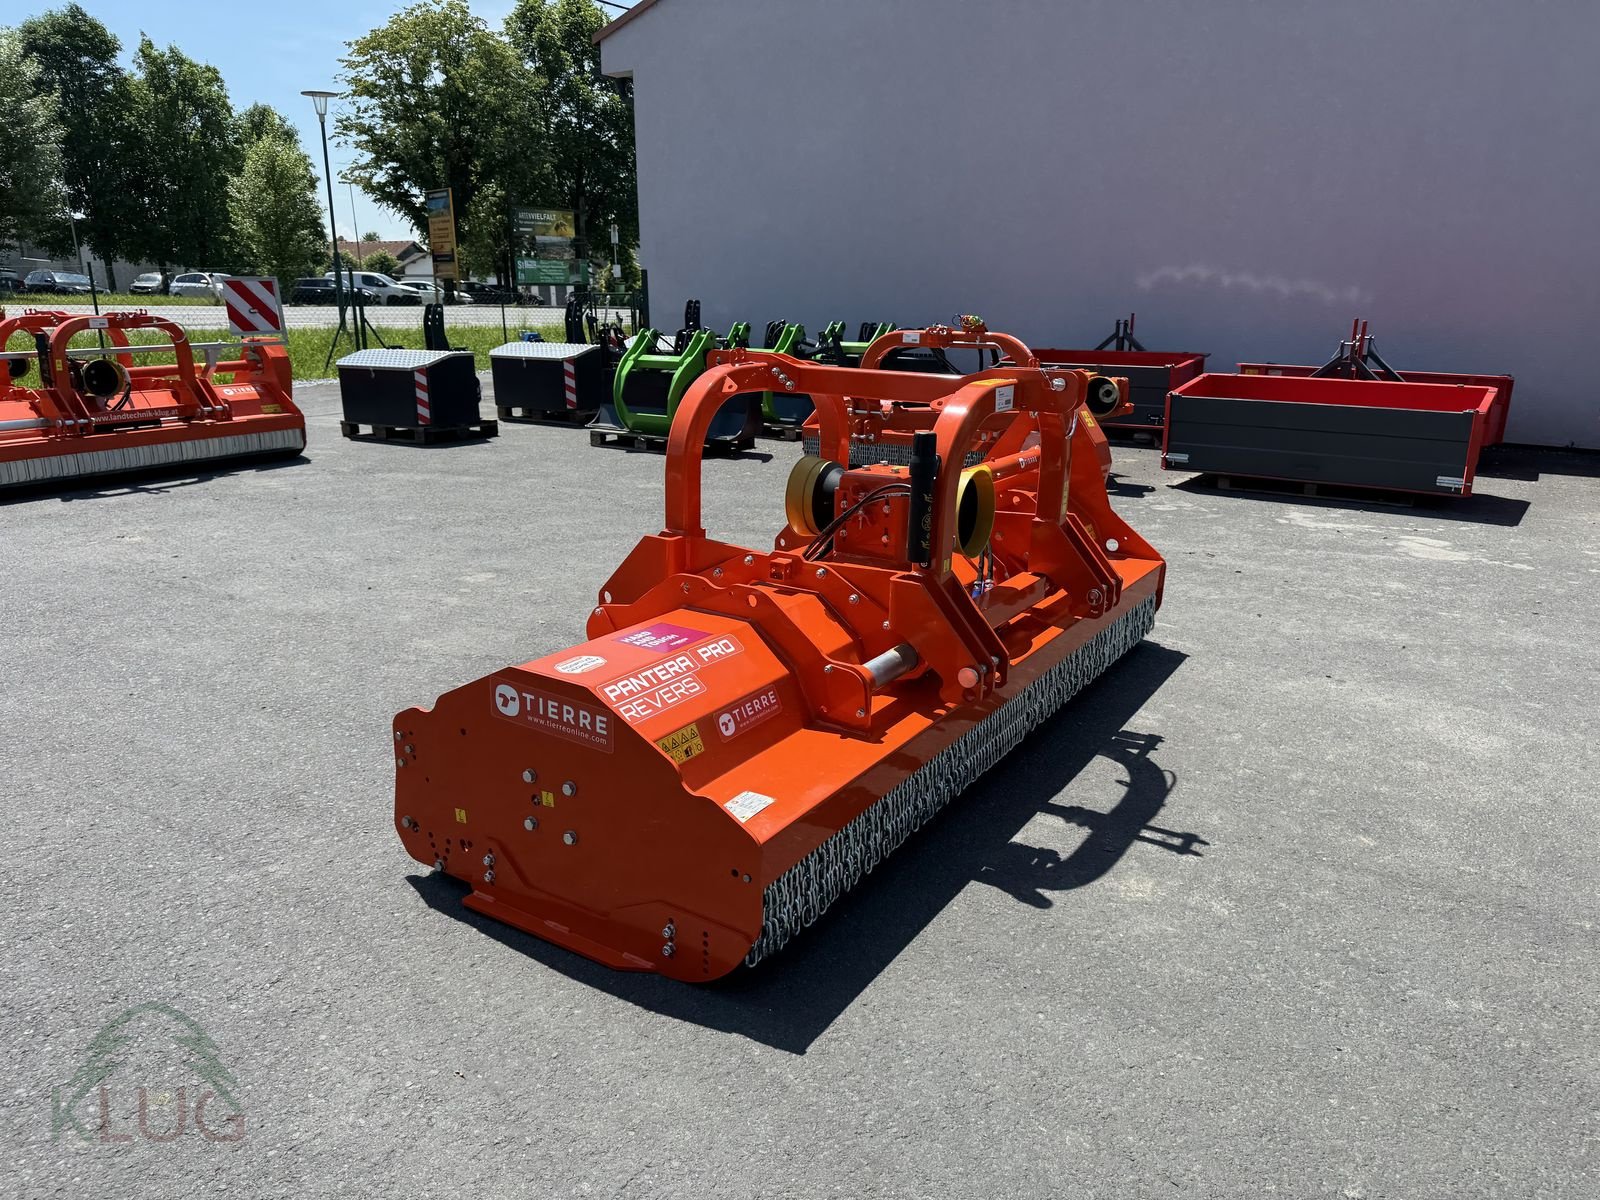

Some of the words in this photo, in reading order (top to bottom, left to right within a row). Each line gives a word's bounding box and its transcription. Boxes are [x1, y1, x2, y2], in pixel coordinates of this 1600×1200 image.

[604, 656, 695, 702] PANTERA
[697, 639, 735, 662] PRO
[522, 692, 608, 735] TIERRE
[619, 678, 701, 721] REVERS
[732, 691, 777, 722] TIERRE
[527, 715, 607, 745] www.tierreonline.com
